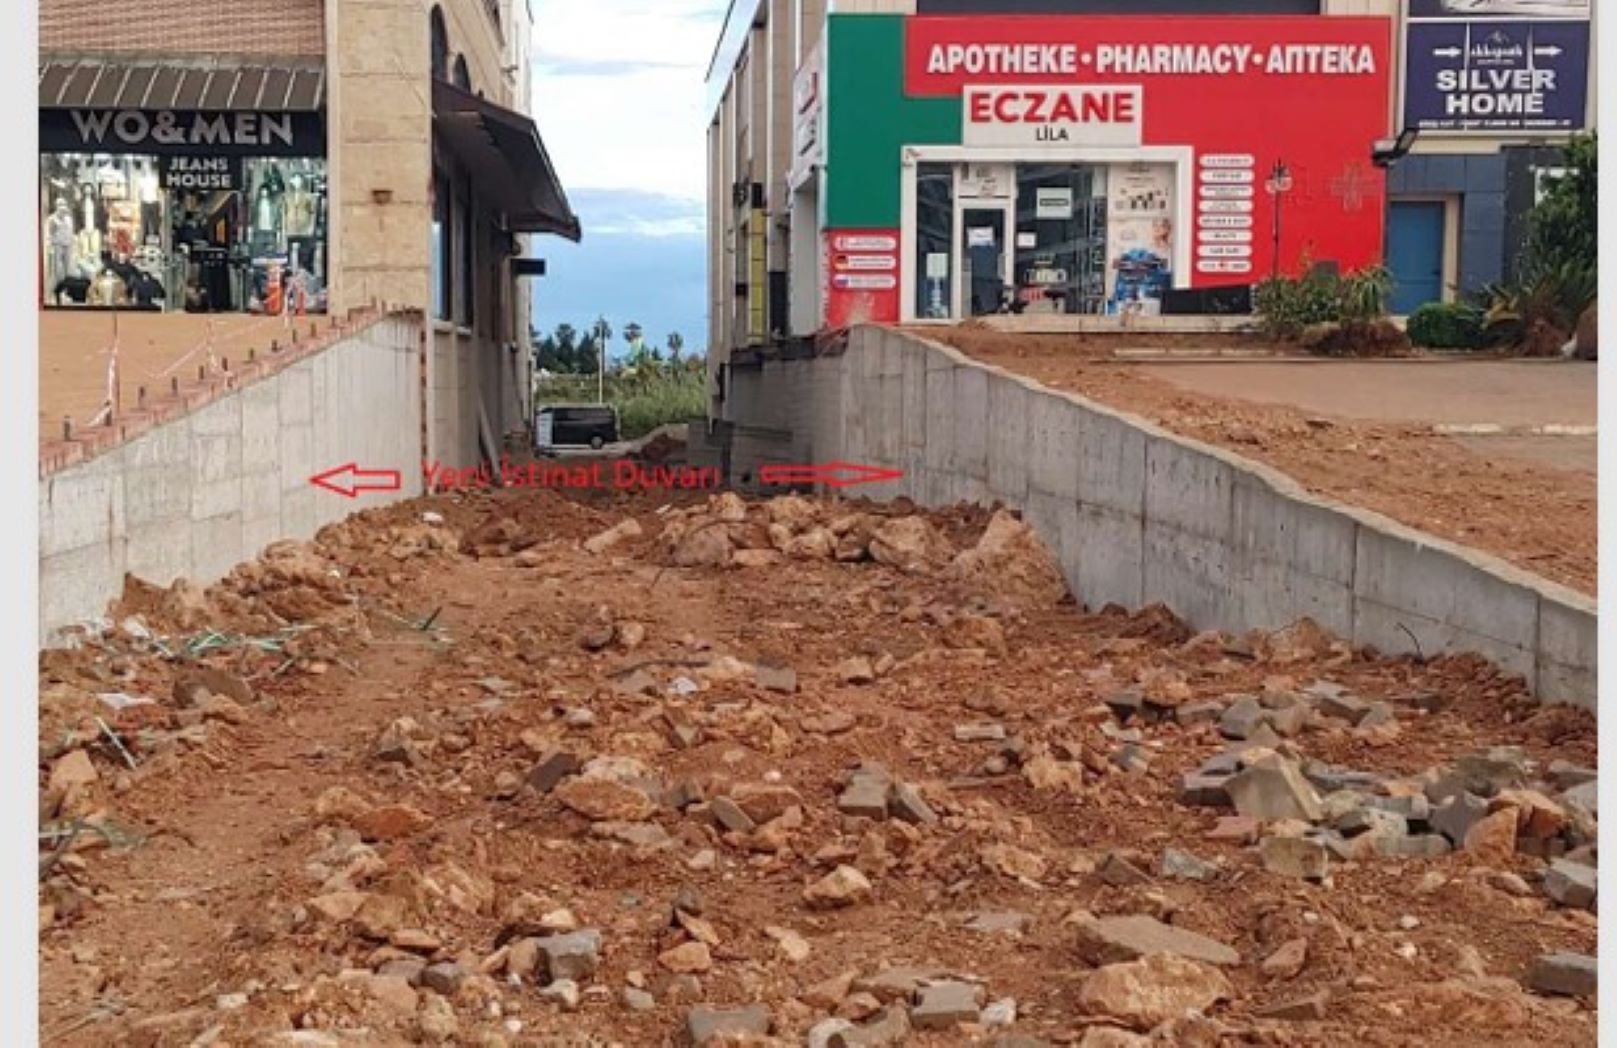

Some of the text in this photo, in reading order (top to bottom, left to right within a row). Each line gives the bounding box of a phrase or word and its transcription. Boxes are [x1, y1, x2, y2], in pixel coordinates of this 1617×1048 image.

[927, 44, 1077, 74] APOTHEKE
[1096, 44, 1252, 74] PHARMACY
[1435, 69, 1557, 91] SILVER
[970, 92, 1135, 124] ECZANE
[1445, 92, 1544, 114] HOME
[70, 109, 294, 146] WO&MEN
[168, 157, 229, 172] JEANS
[165, 173, 232, 188] HOUSE
